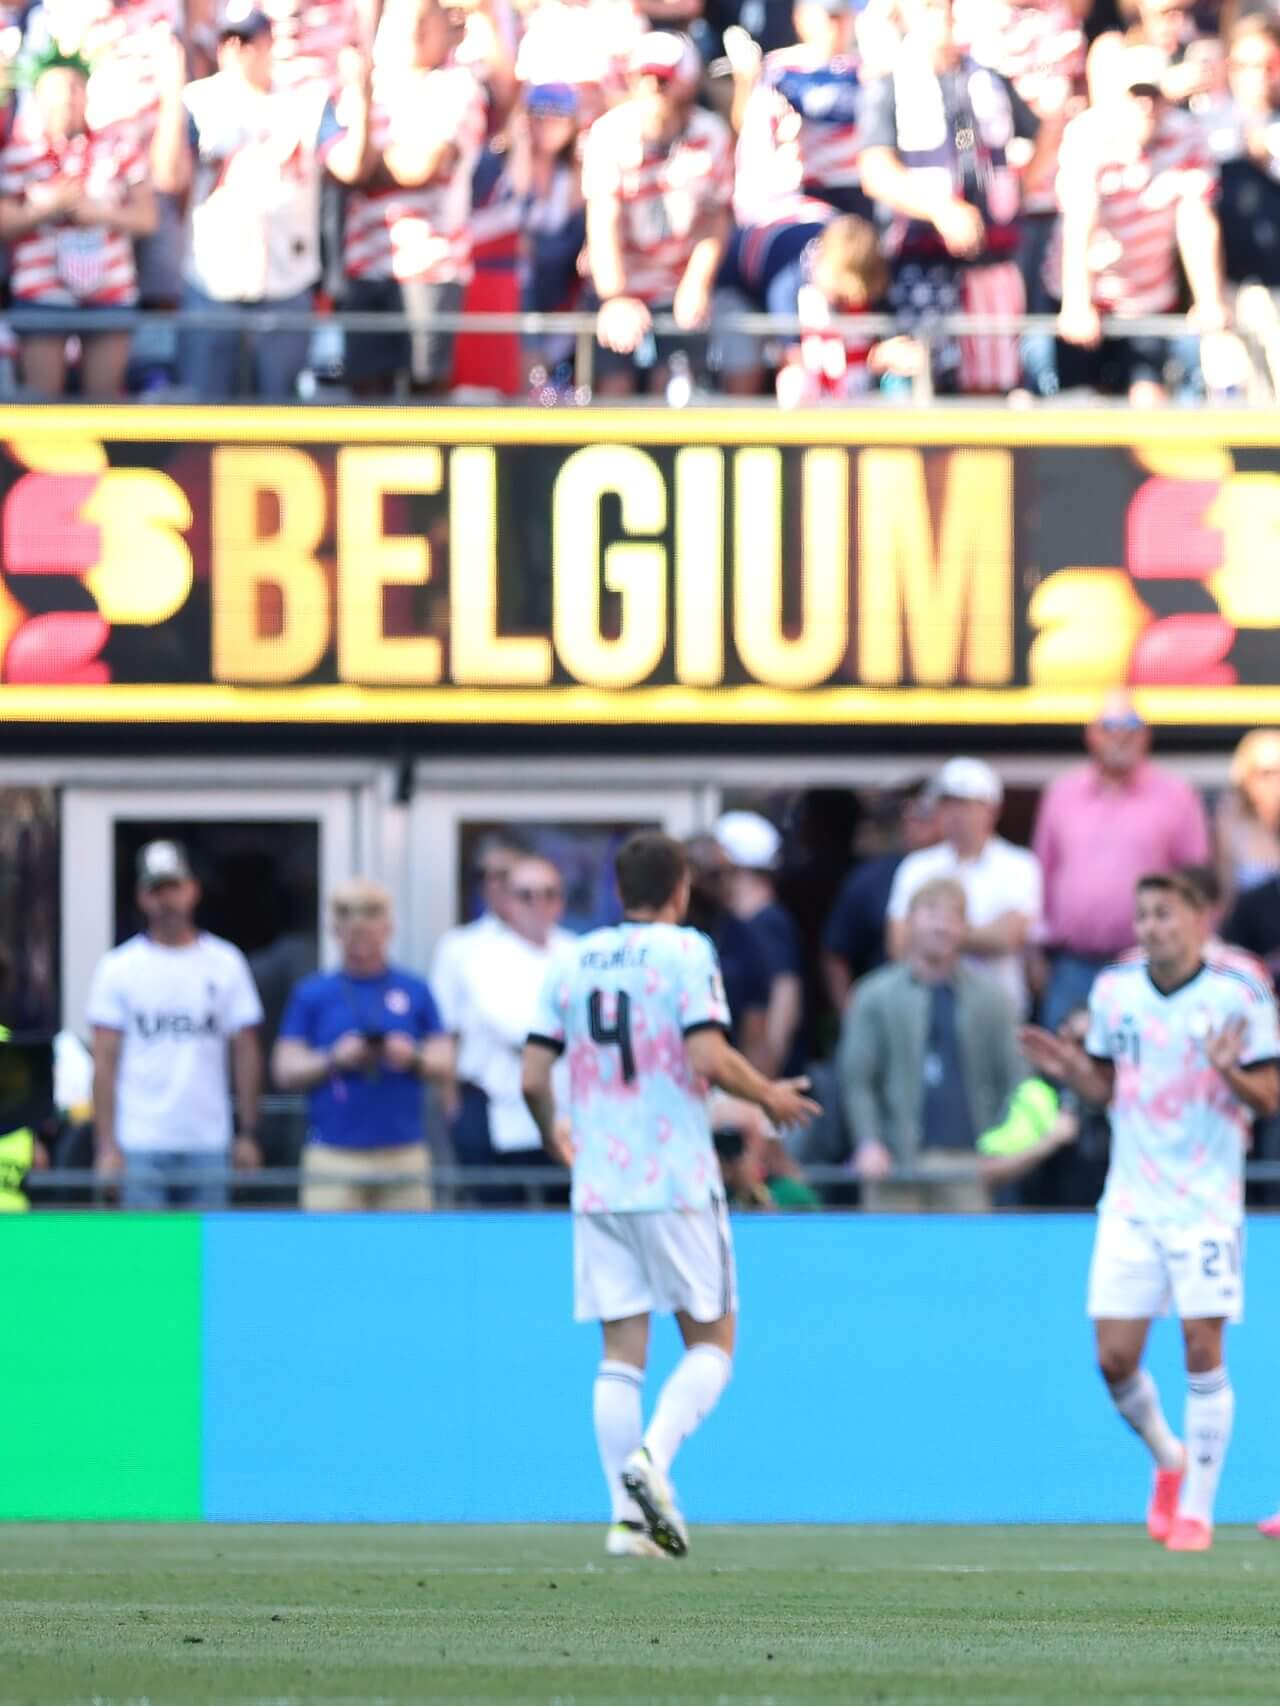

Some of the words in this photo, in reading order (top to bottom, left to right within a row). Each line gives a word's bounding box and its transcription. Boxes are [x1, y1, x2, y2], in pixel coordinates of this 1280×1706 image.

[211, 444, 1015, 687] BELGIUM
[587, 986, 637, 1087] 4
[1201, 1239, 1239, 1277] 21
